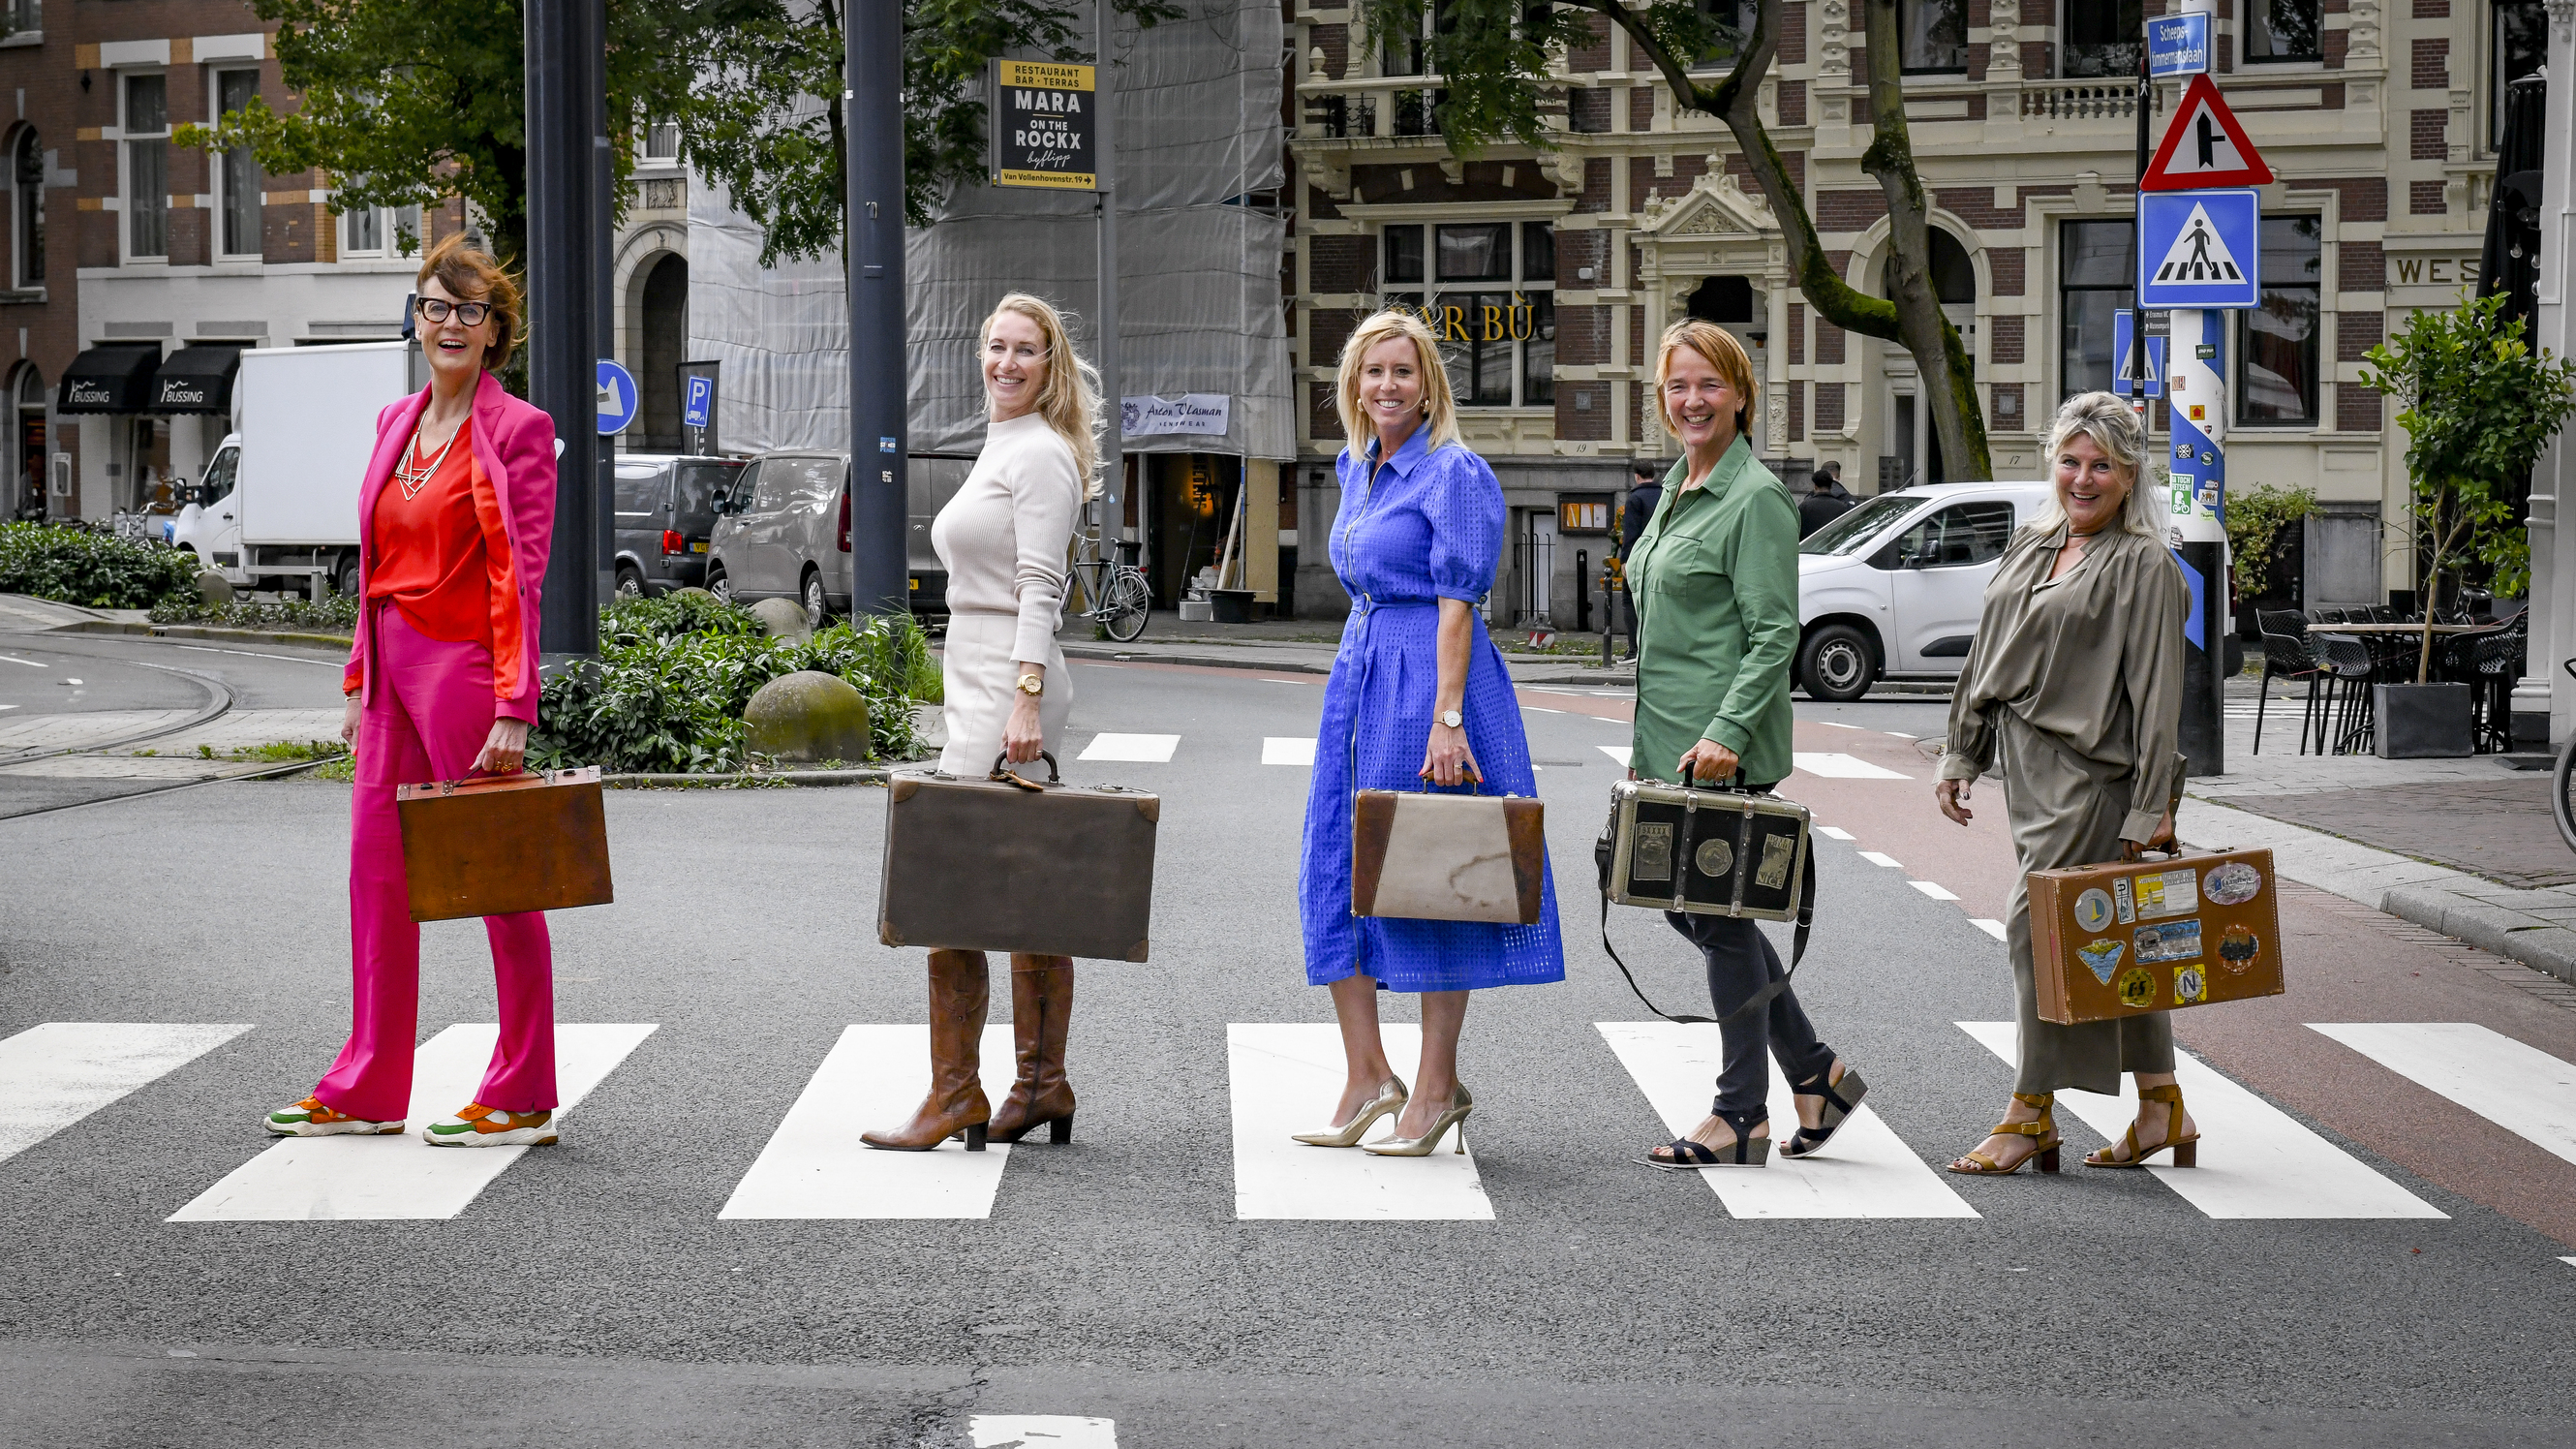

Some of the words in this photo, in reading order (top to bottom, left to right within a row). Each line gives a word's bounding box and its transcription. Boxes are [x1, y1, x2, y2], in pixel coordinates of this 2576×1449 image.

[2160, 24, 2189, 44] Scheeps-
[1015, 65, 1080, 77] RESTAURANT
[1015, 76, 1034, 84] BAR
[1043, 77, 1080, 87] TERRAS
[1015, 89, 1082, 113] MARA
[1029, 119, 1046, 130] ON
[1048, 120, 1068, 131] THE
[1015, 129, 1082, 150] ROCKX
[1004, 172, 1017, 181] Van
[1018, 172, 1074, 184] Vollenhovenstr.
[1074, 175, 1083, 184] 19
[1482, 291, 1536, 341] BÙ
[2149, 310, 2163, 319] Erasmus
[2149, 322, 2170, 330] Museumpark
[75, 390, 110, 403] BUSSING
[166, 390, 203, 403] BUSSING
[691, 382, 706, 406] P
[1576, 444, 1587, 453] 19
[2009, 455, 2022, 465] 17
[2177, 476, 2192, 484] TOCH
[1756, 874, 1783, 887] NICE
[2182, 974, 2196, 993] N
